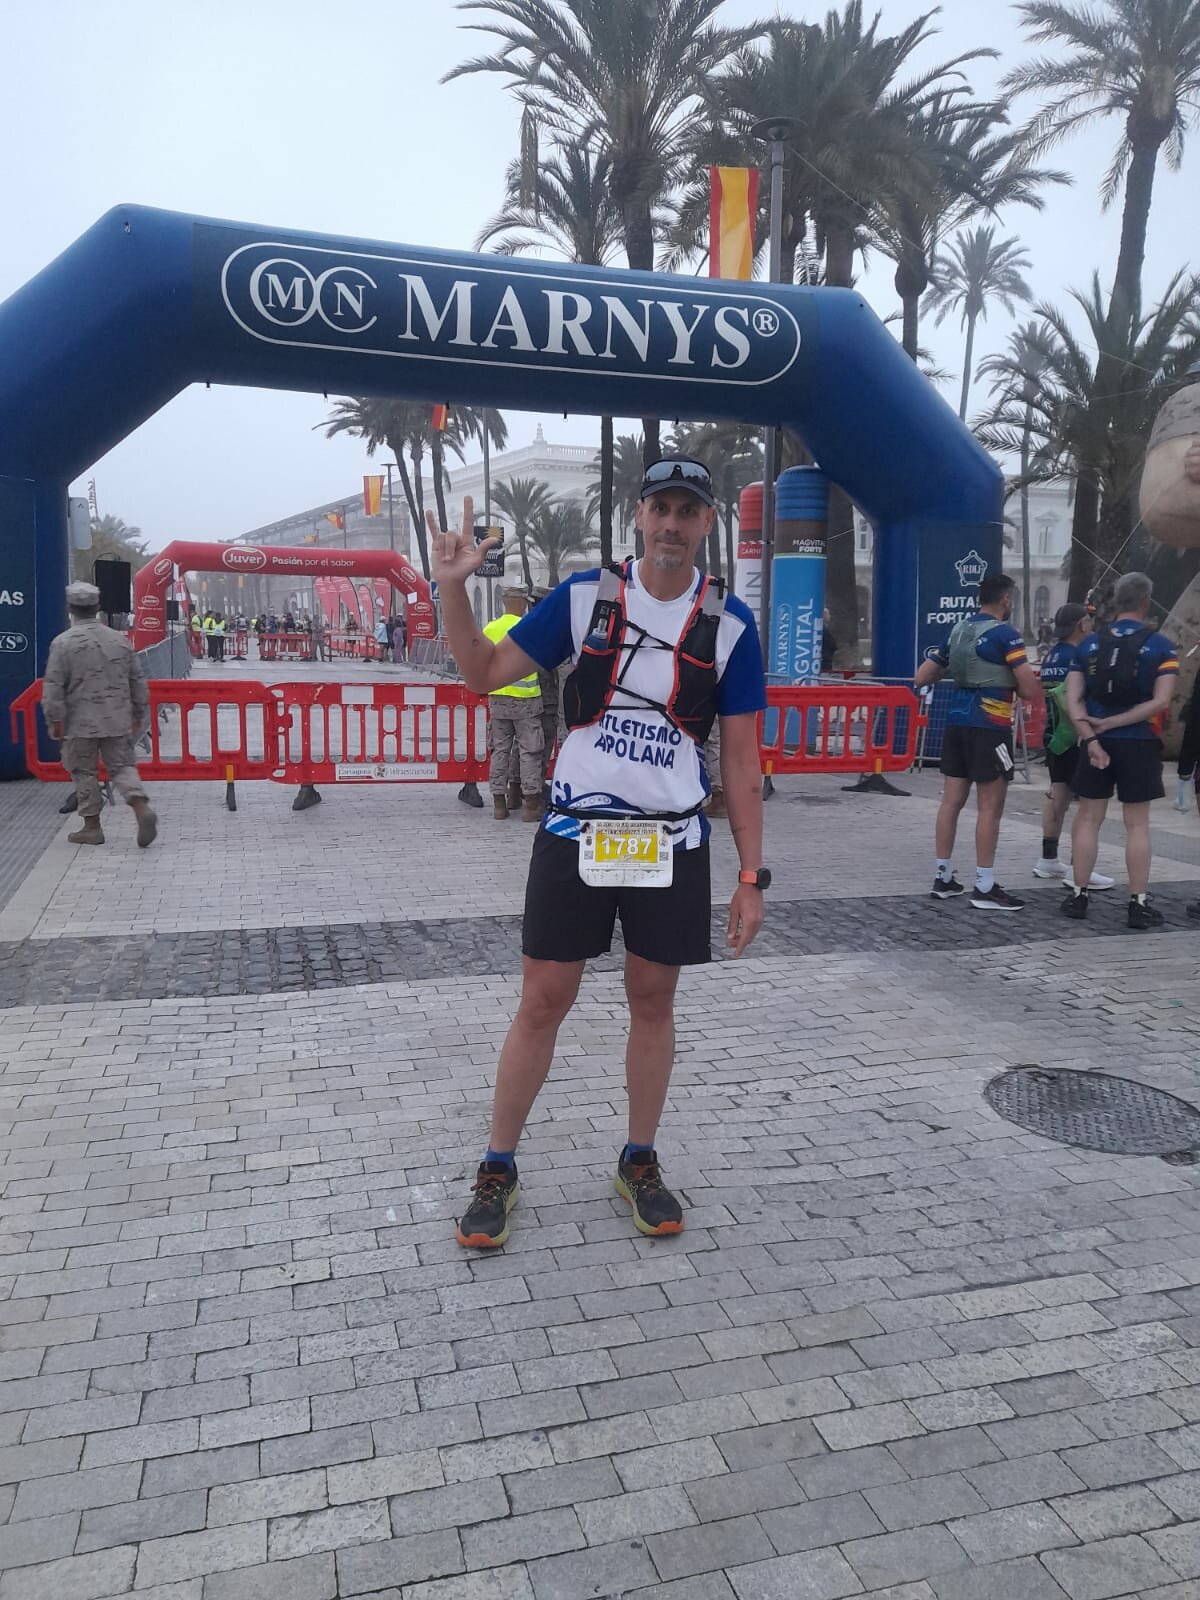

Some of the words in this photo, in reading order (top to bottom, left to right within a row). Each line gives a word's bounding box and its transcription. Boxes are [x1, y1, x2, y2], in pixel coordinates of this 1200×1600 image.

[227, 553, 262, 564] Juver
[272, 556, 303, 566] Pasión
[305, 559, 319, 567] por
[321, 558, 329, 566] el
[331, 559, 356, 567] sabor
[594, 732, 675, 769] APOLANA
[601, 837, 652, 855] 1787
